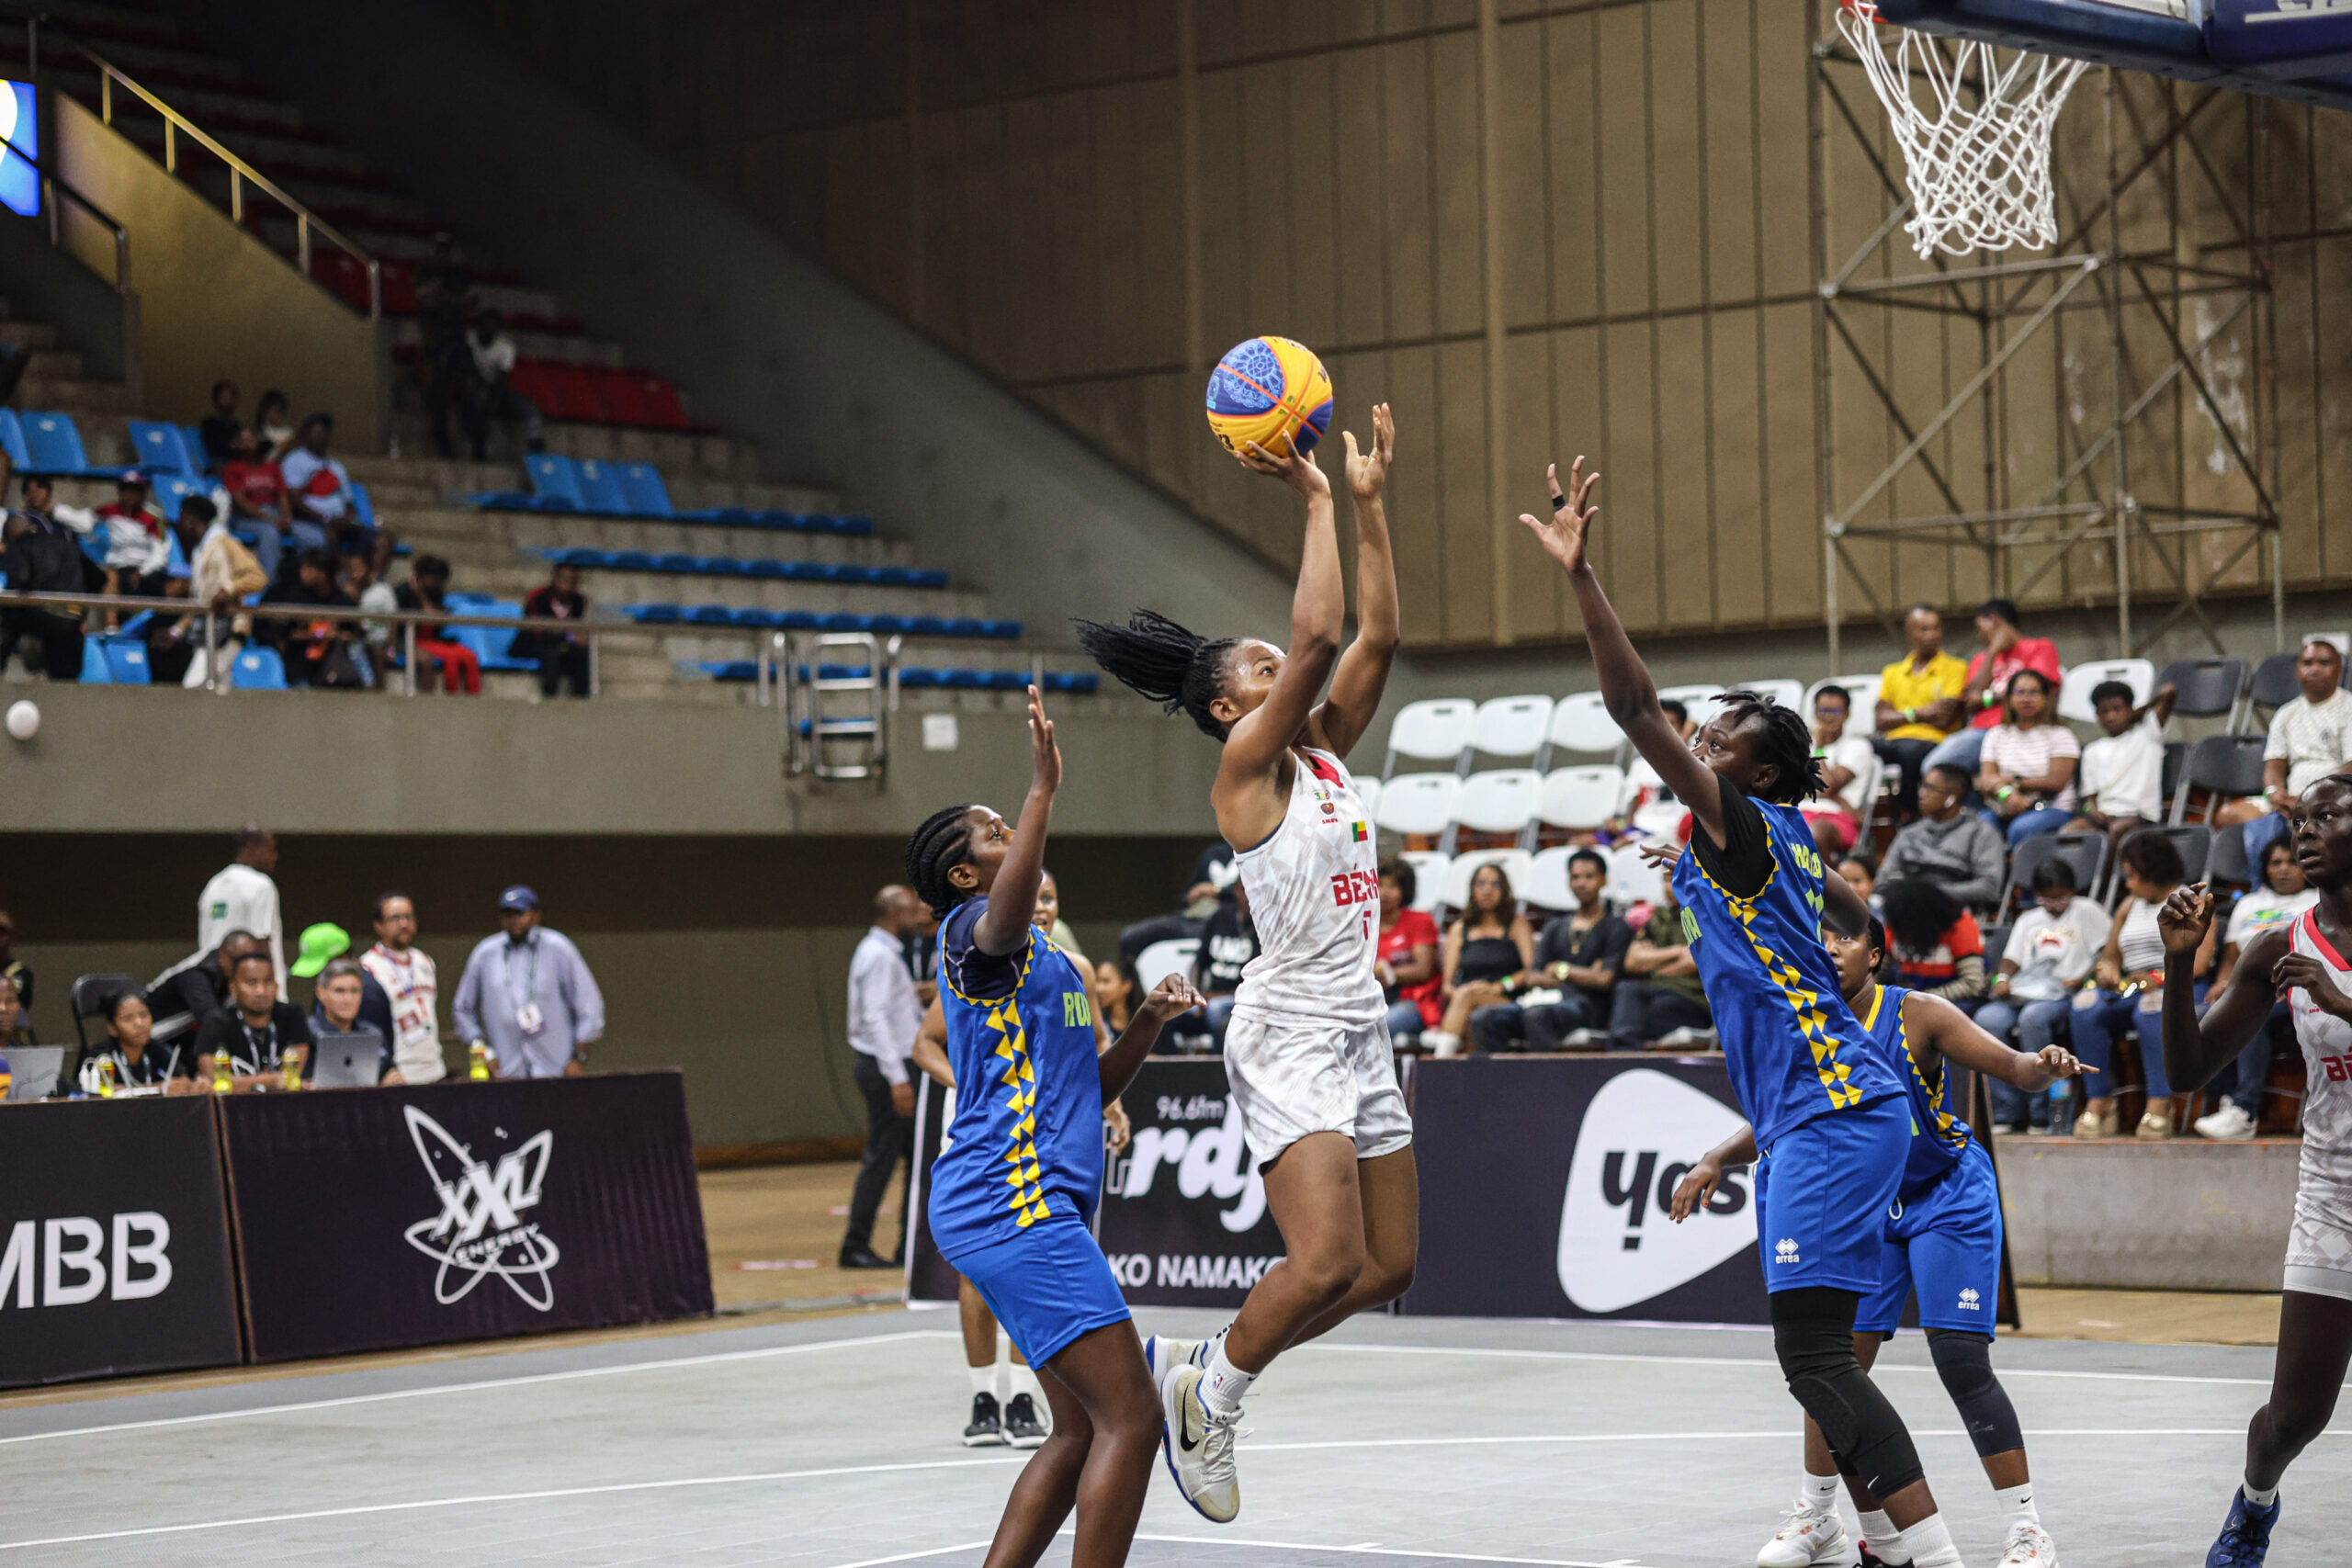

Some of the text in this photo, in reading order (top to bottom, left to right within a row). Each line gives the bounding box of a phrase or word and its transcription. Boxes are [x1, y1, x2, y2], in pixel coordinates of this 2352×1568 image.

[1156, 1095, 1224, 1121] 96.6fm
[432, 1153, 542, 1244] XXL
[456, 1223, 540, 1264] ENERGY
[1157, 1254, 1286, 1289] NAMAK
